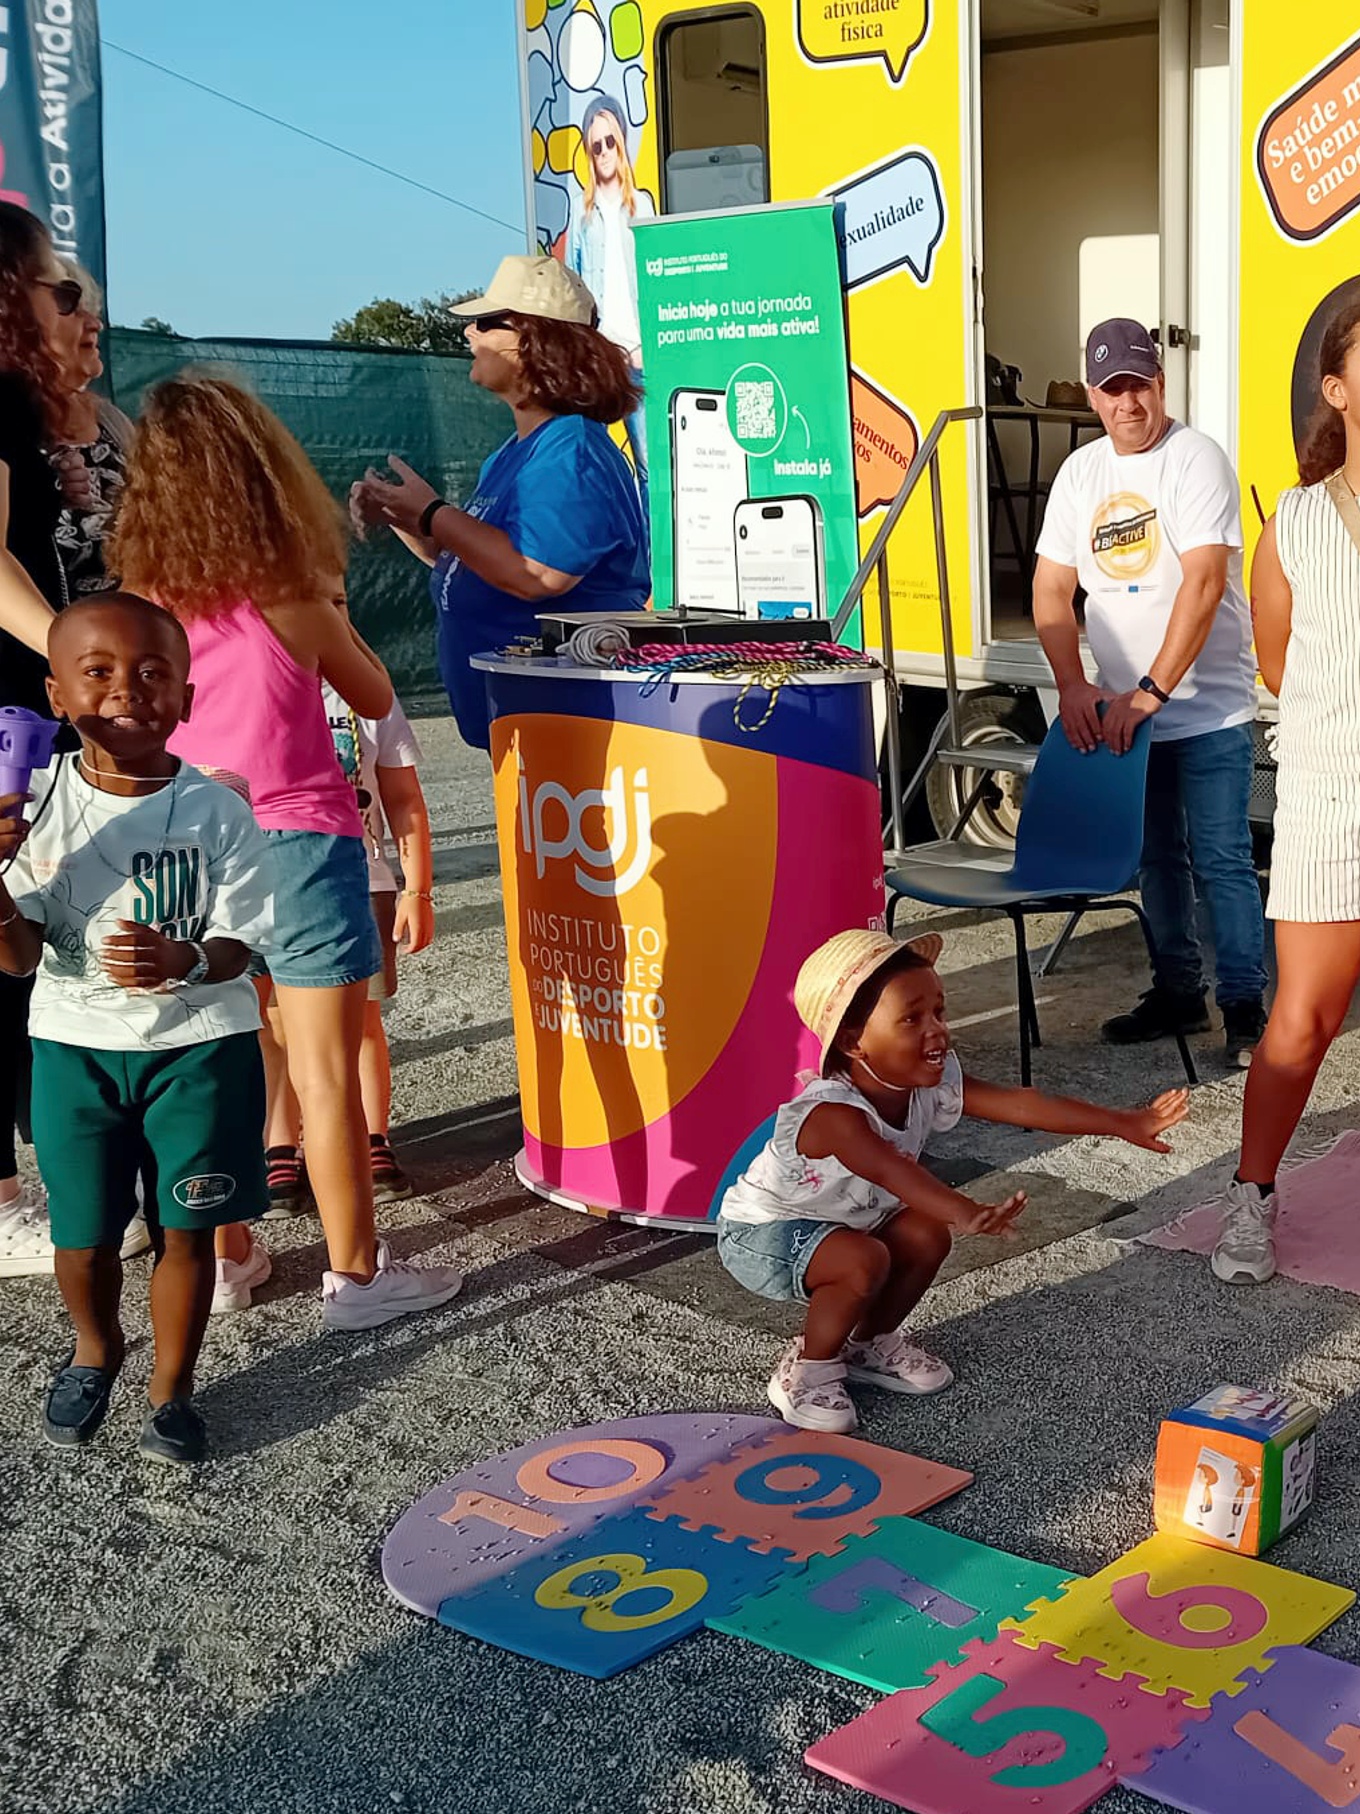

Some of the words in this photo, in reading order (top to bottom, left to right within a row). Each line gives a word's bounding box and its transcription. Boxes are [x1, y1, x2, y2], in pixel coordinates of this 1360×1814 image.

[823, 0, 898, 20] atividade
[841, 20, 884, 42] física
[1267, 99, 1339, 168] Saúde
[1290, 162, 1305, 184] e
[840, 195, 924, 249] exualidade
[658, 302, 688, 321] Inicia
[690, 299, 718, 322] hoje
[720, 303, 729, 316] a
[731, 299, 755, 315] tua
[757, 292, 812, 318] jornada
[658, 329, 685, 348] para
[687, 327, 714, 341] uma
[717, 321, 745, 340] vida
[748, 318, 778, 337] mais
[781, 315, 820, 336] ativa!
[774, 458, 818, 476] Instala
[819, 458, 832, 479] já
[853, 417, 909, 470] amentos
[518, 751, 652, 897] ipdj
[132, 847, 200, 926] SON
[527, 908, 660, 956] INSTITUTO
[530, 943, 663, 989] PORTUGUÊS
[543, 975, 665, 1020] DESPORTO
[539, 1004, 667, 1051] JUVENTUDE
[438, 1437, 667, 1538] 10
[734, 1453, 882, 1520] 9
[534, 1554, 708, 1632] 8
[808, 1556, 984, 1628] 7
[1111, 1572, 1269, 1649] 6
[918, 1673, 1108, 1787] 5
